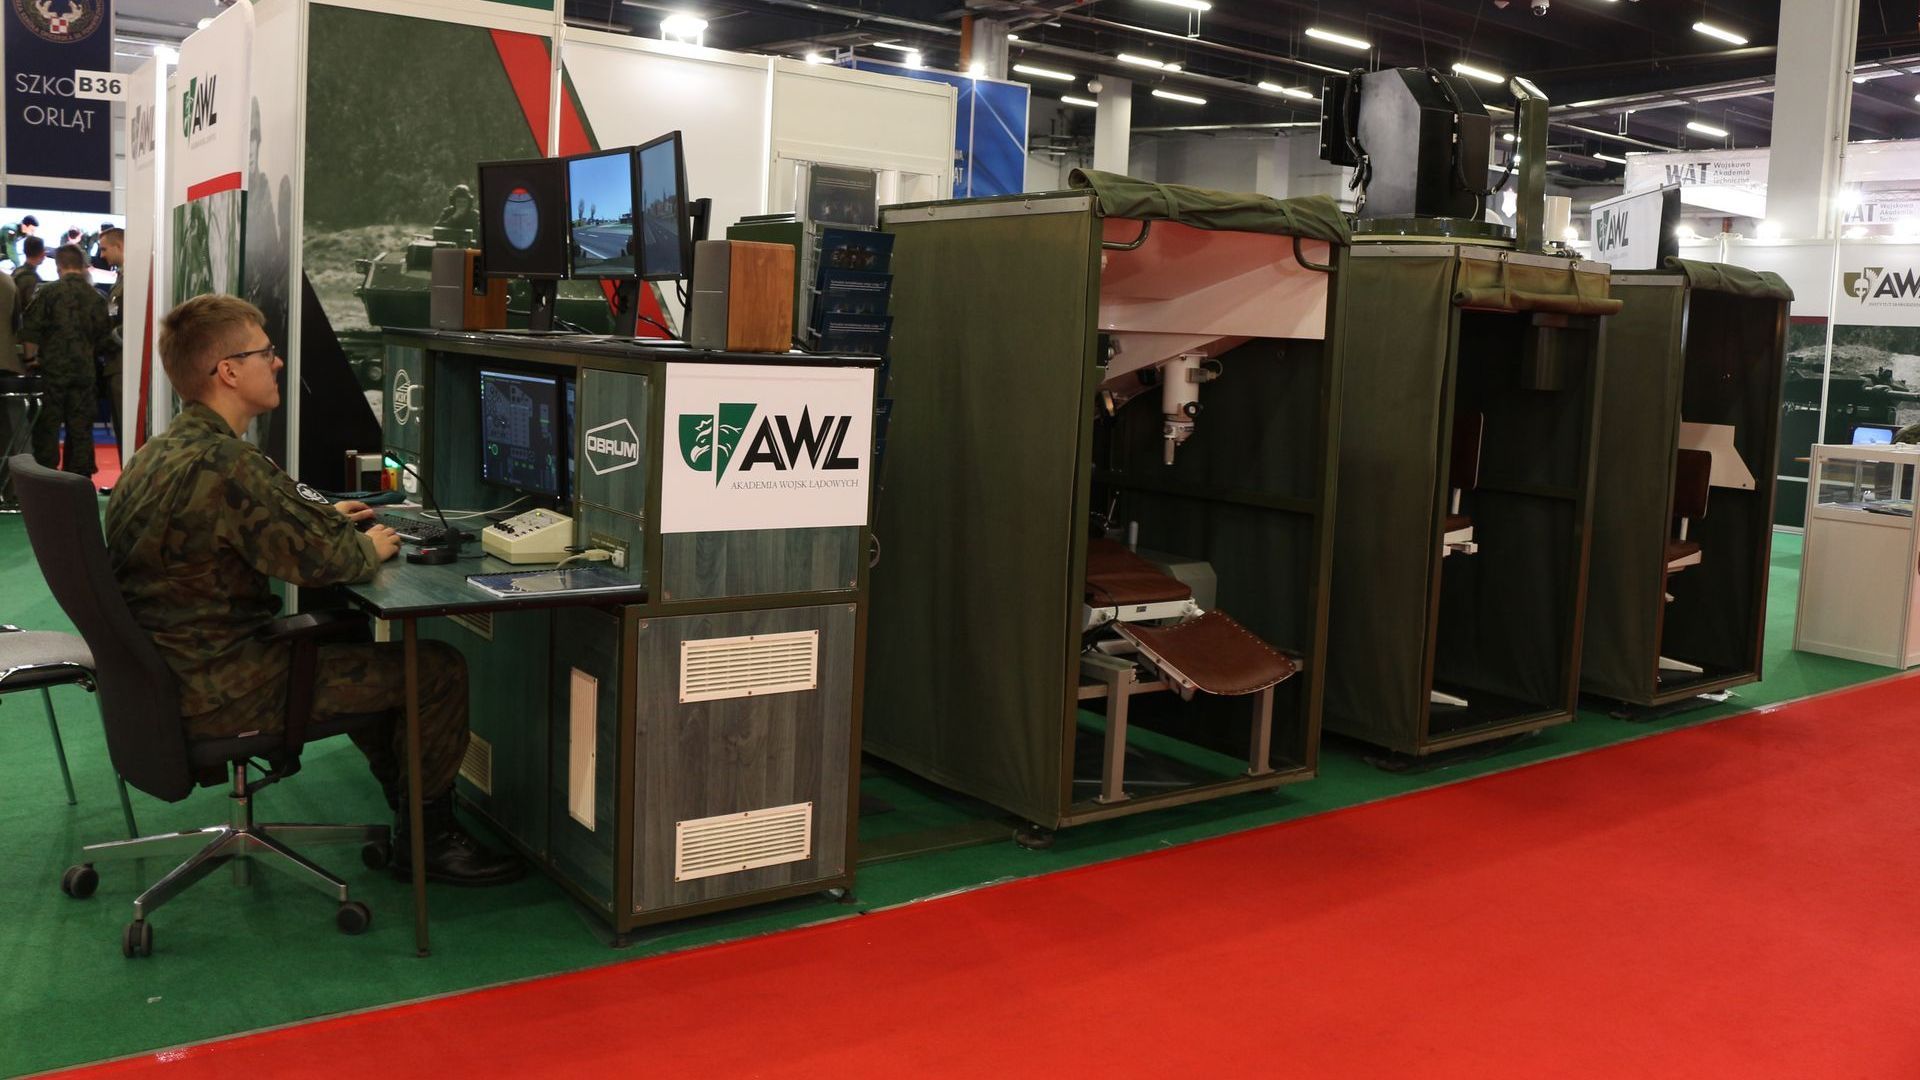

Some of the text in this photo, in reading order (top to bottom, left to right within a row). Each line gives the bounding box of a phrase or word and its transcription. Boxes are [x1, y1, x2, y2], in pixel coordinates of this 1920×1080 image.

[16, 73, 76, 97] SZKO
[79, 76, 122, 95] B36
[192, 71, 217, 135] AWL
[24, 105, 95, 133] ORLĄT
[1665, 162, 1711, 185] WAT
[1713, 161, 1751, 170] Wojskowa
[1606, 207, 1629, 250] AWL
[1873, 267, 1920, 299] AW
[588, 435, 637, 459] OBRUM
[738, 403, 860, 472] AWL
[731, 481, 779, 490] AKADEMIA
[780, 480, 808, 490] WOJSK
